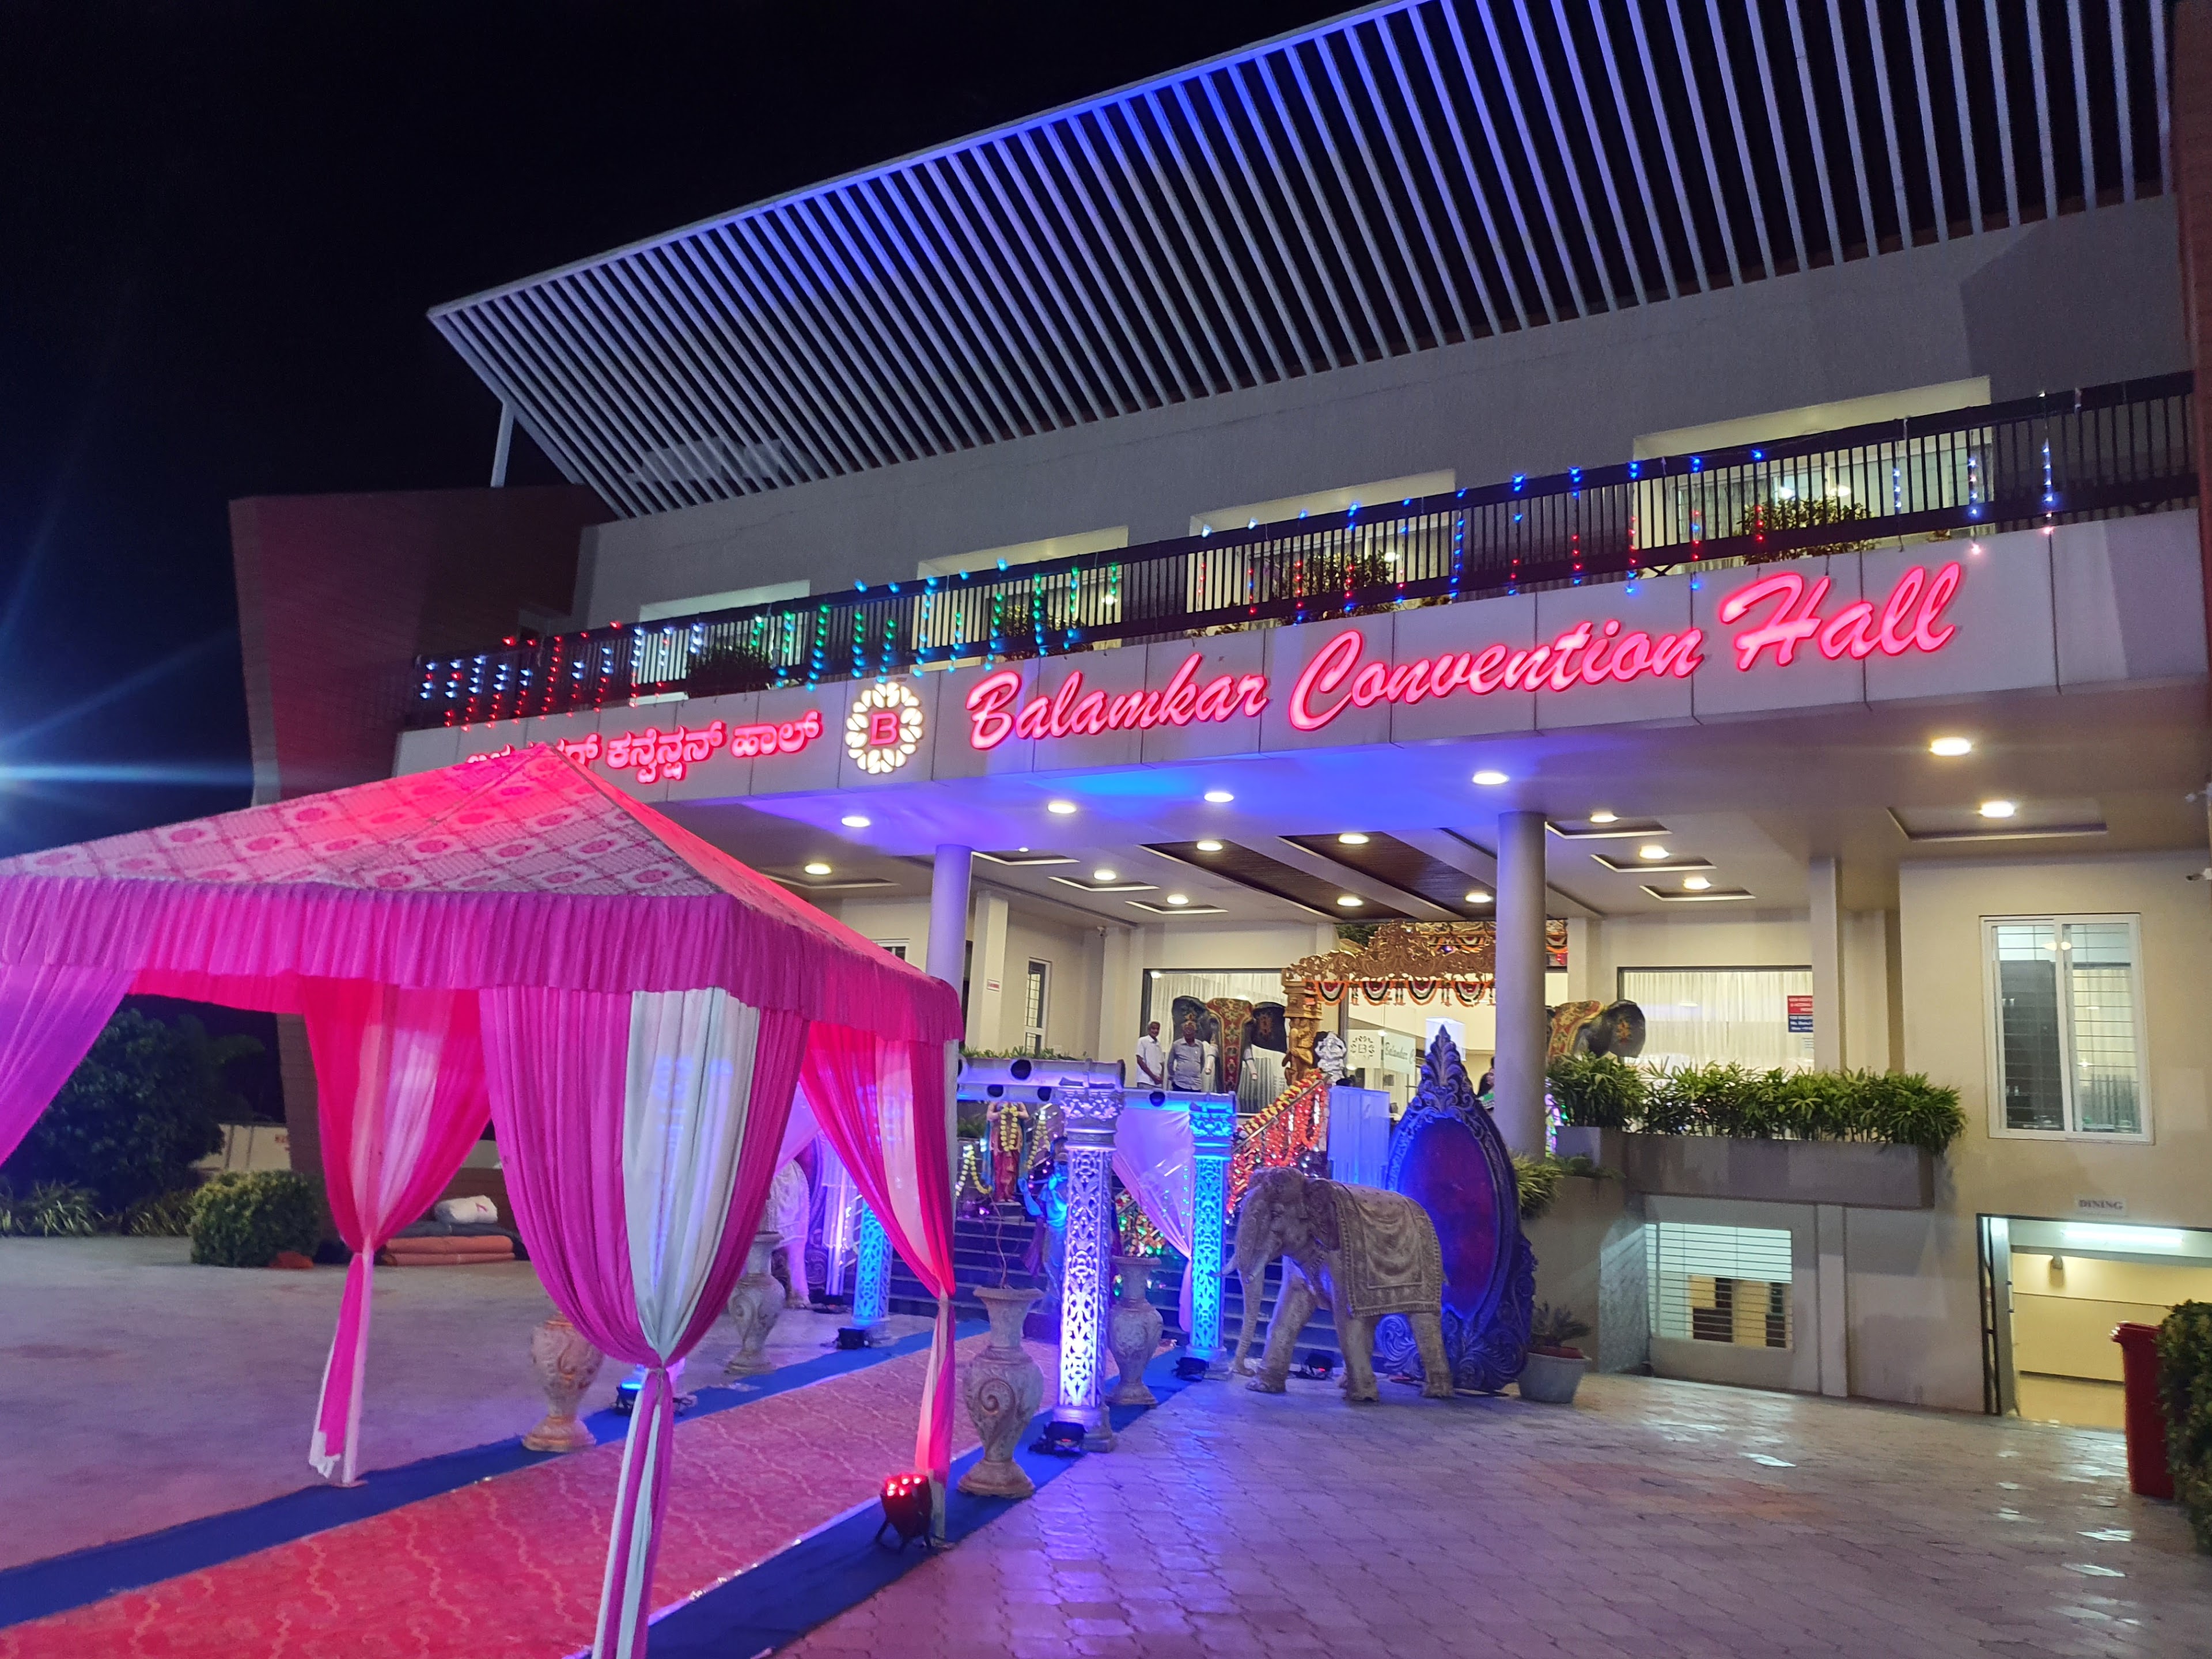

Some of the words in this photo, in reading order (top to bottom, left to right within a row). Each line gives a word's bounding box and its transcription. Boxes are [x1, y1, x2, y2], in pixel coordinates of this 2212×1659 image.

[968, 652, 1269, 750] Balamkar
[1289, 630, 1704, 731] Convention
[1721, 563, 1961, 672] Hall
[730, 710, 823, 758] ಹಾಲ್
[869, 712, 896, 745] B
[2079, 1199, 2123, 1210] DINING
